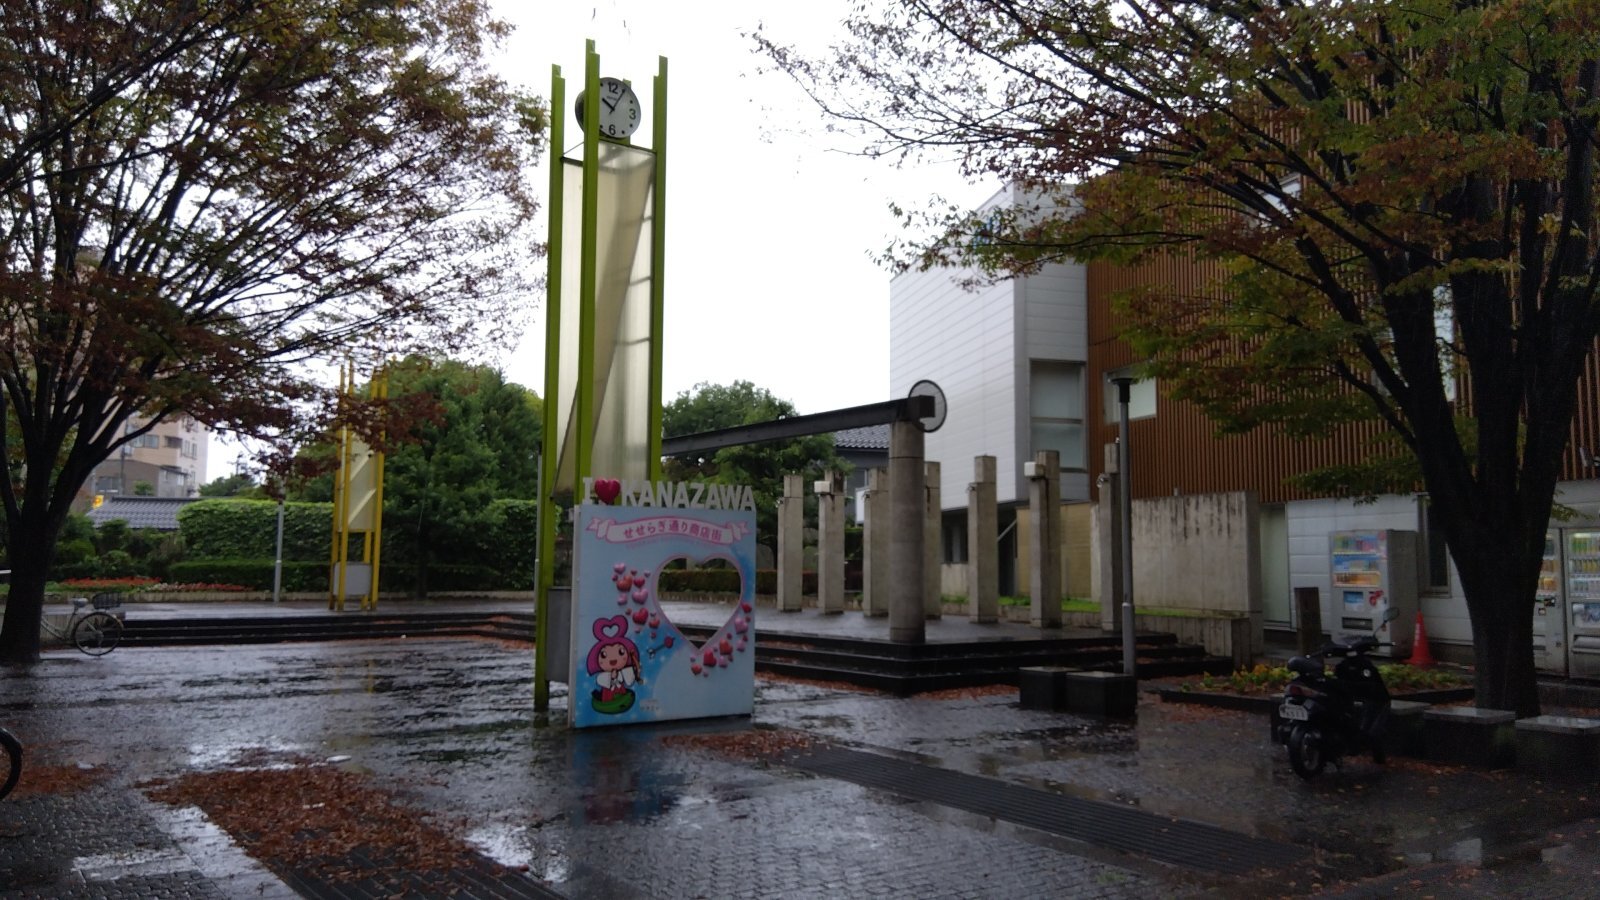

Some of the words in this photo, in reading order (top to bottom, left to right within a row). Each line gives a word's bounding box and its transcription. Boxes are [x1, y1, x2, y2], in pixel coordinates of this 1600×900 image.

[608, 81, 618, 94] 12
[629, 108, 636, 120] 3
[608, 124, 616, 136] 6
[583, 477, 595, 505] I
[621, 479, 756, 512] KANAZAWA
[624, 519, 722, 542] せせらぎ通り商店街
